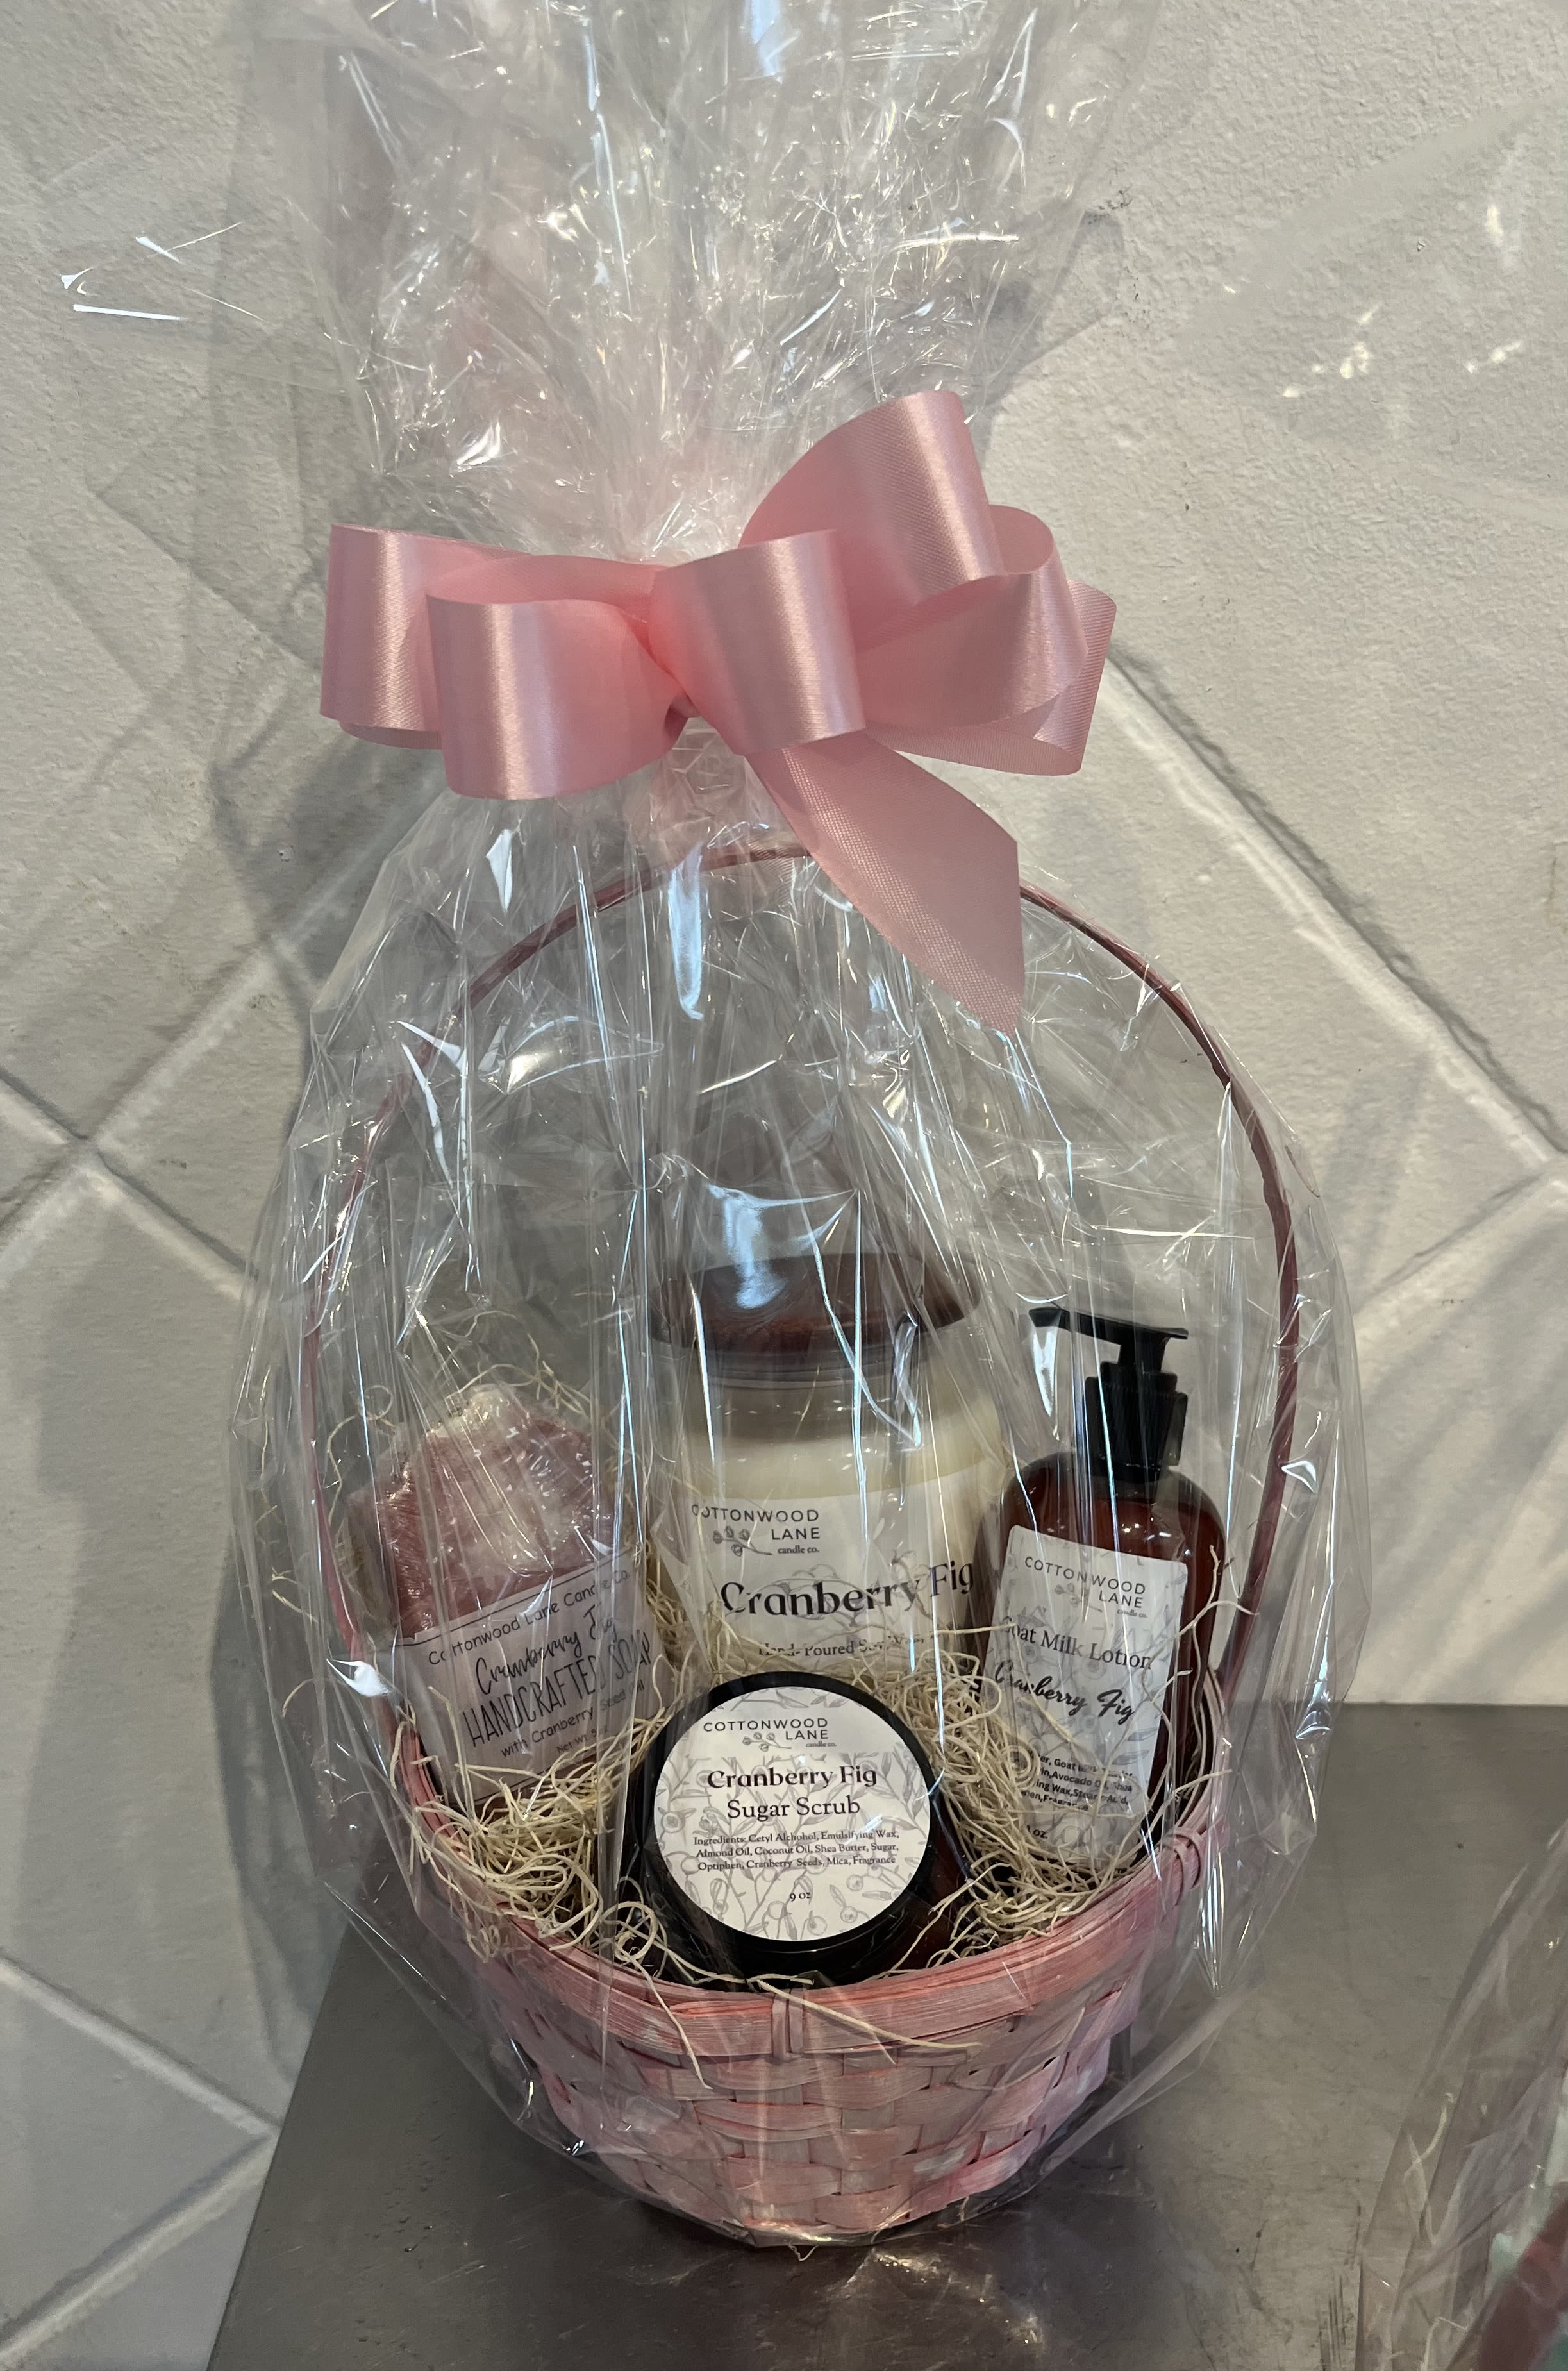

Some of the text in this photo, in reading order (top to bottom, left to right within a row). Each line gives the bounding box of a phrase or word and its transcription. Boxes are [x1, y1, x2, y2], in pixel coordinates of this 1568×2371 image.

[691, 1504, 819, 1523] COTTONWOOD
[771, 1527, 821, 1541] LANE
[777, 1545, 805, 1554] candle
[1024, 1556, 1146, 1595] COTTONWOOD
[720, 1559, 974, 1616] Cranberry Fig
[524, 1602, 560, 1625] Lane
[564, 1579, 610, 1607] Cande
[1099, 1591, 1144, 1609] LANE
[805, 1641, 855, 1657] Poured
[1040, 1630, 1085, 1657] Milk
[1089, 1643, 1151, 1670] Lotion
[476, 1631, 583, 1695] Cranberry
[462, 1630, 652, 1748] HANDCRAFTED SOAP
[1097, 1689, 1135, 1725] Fig
[501, 1738, 528, 1757] with
[531, 1707, 594, 1743] Cranberry
[703, 1718, 828, 1732] COTTONWOOD
[785, 1729, 829, 1740] LANE
[1054, 1758, 1076, 1770] Goat
[707, 1764, 878, 1789] Cranberry Fig
[1094, 1779, 1109, 1791] Ol,
[727, 1795, 861, 1822] Sugar Scrub
[694, 1829, 899, 1846] Ingredients: Cetyl Alchohol, Emulsifying Wax,
[696, 1842, 899, 1858] Almond Oil, Coconut Oil, Shea Butter, Sugar,
[697, 1855, 896, 1873] Optiphen, Cranberry Seeds, Mica, Fragrance
[789, 1893, 796, 1902] 9
